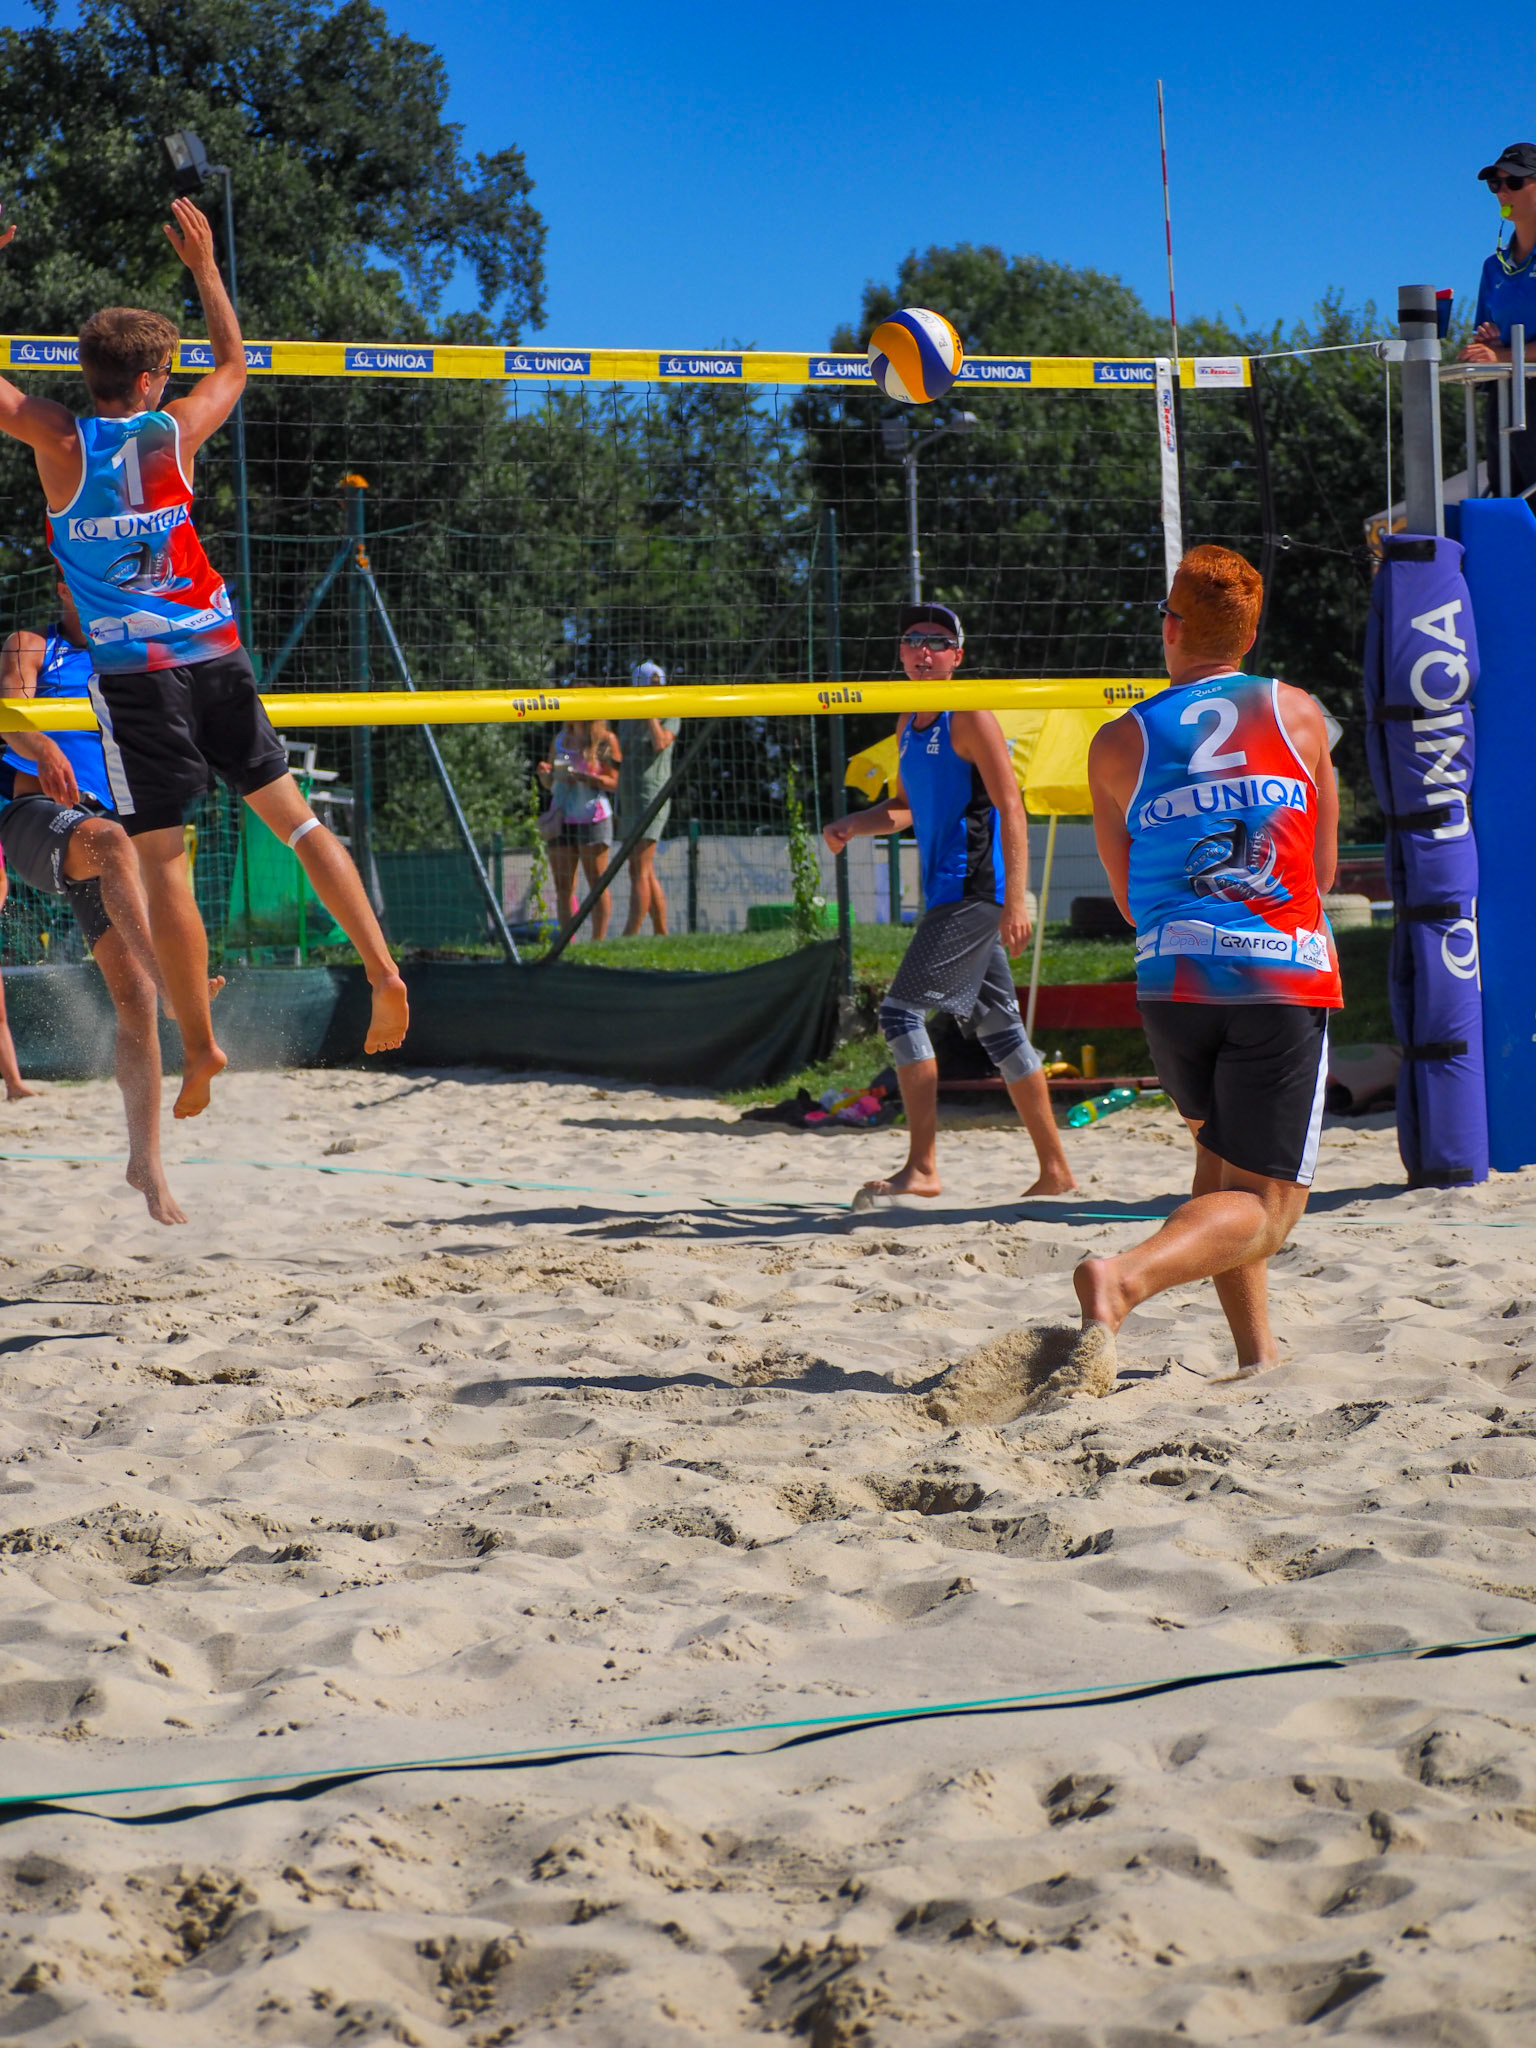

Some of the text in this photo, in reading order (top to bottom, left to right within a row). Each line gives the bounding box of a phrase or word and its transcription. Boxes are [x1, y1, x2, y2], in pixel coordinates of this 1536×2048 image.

[376, 353, 427, 369] UNIQA
[534, 356, 585, 372] UNIQA
[688, 359, 736, 374] UNIQA
[836, 363, 872, 377] UNIQ
[980, 365, 1026, 379] UNIQA
[1119, 367, 1154, 380] UNIQ
[111, 436, 144, 506] 1
[115, 504, 188, 538] UNIQA
[817, 687, 863, 709] gala
[1103, 683, 1145, 705] gala
[512, 693, 560, 717] gala
[1410, 599, 1470, 840] UNIQA
[930, 726, 941, 743] 2
[1180, 697, 1247, 775] 2
[926, 743, 940, 755] CZE
[1192, 779, 1306, 814] UNIQA
[1221, 936, 1287, 952] GRAFICO
